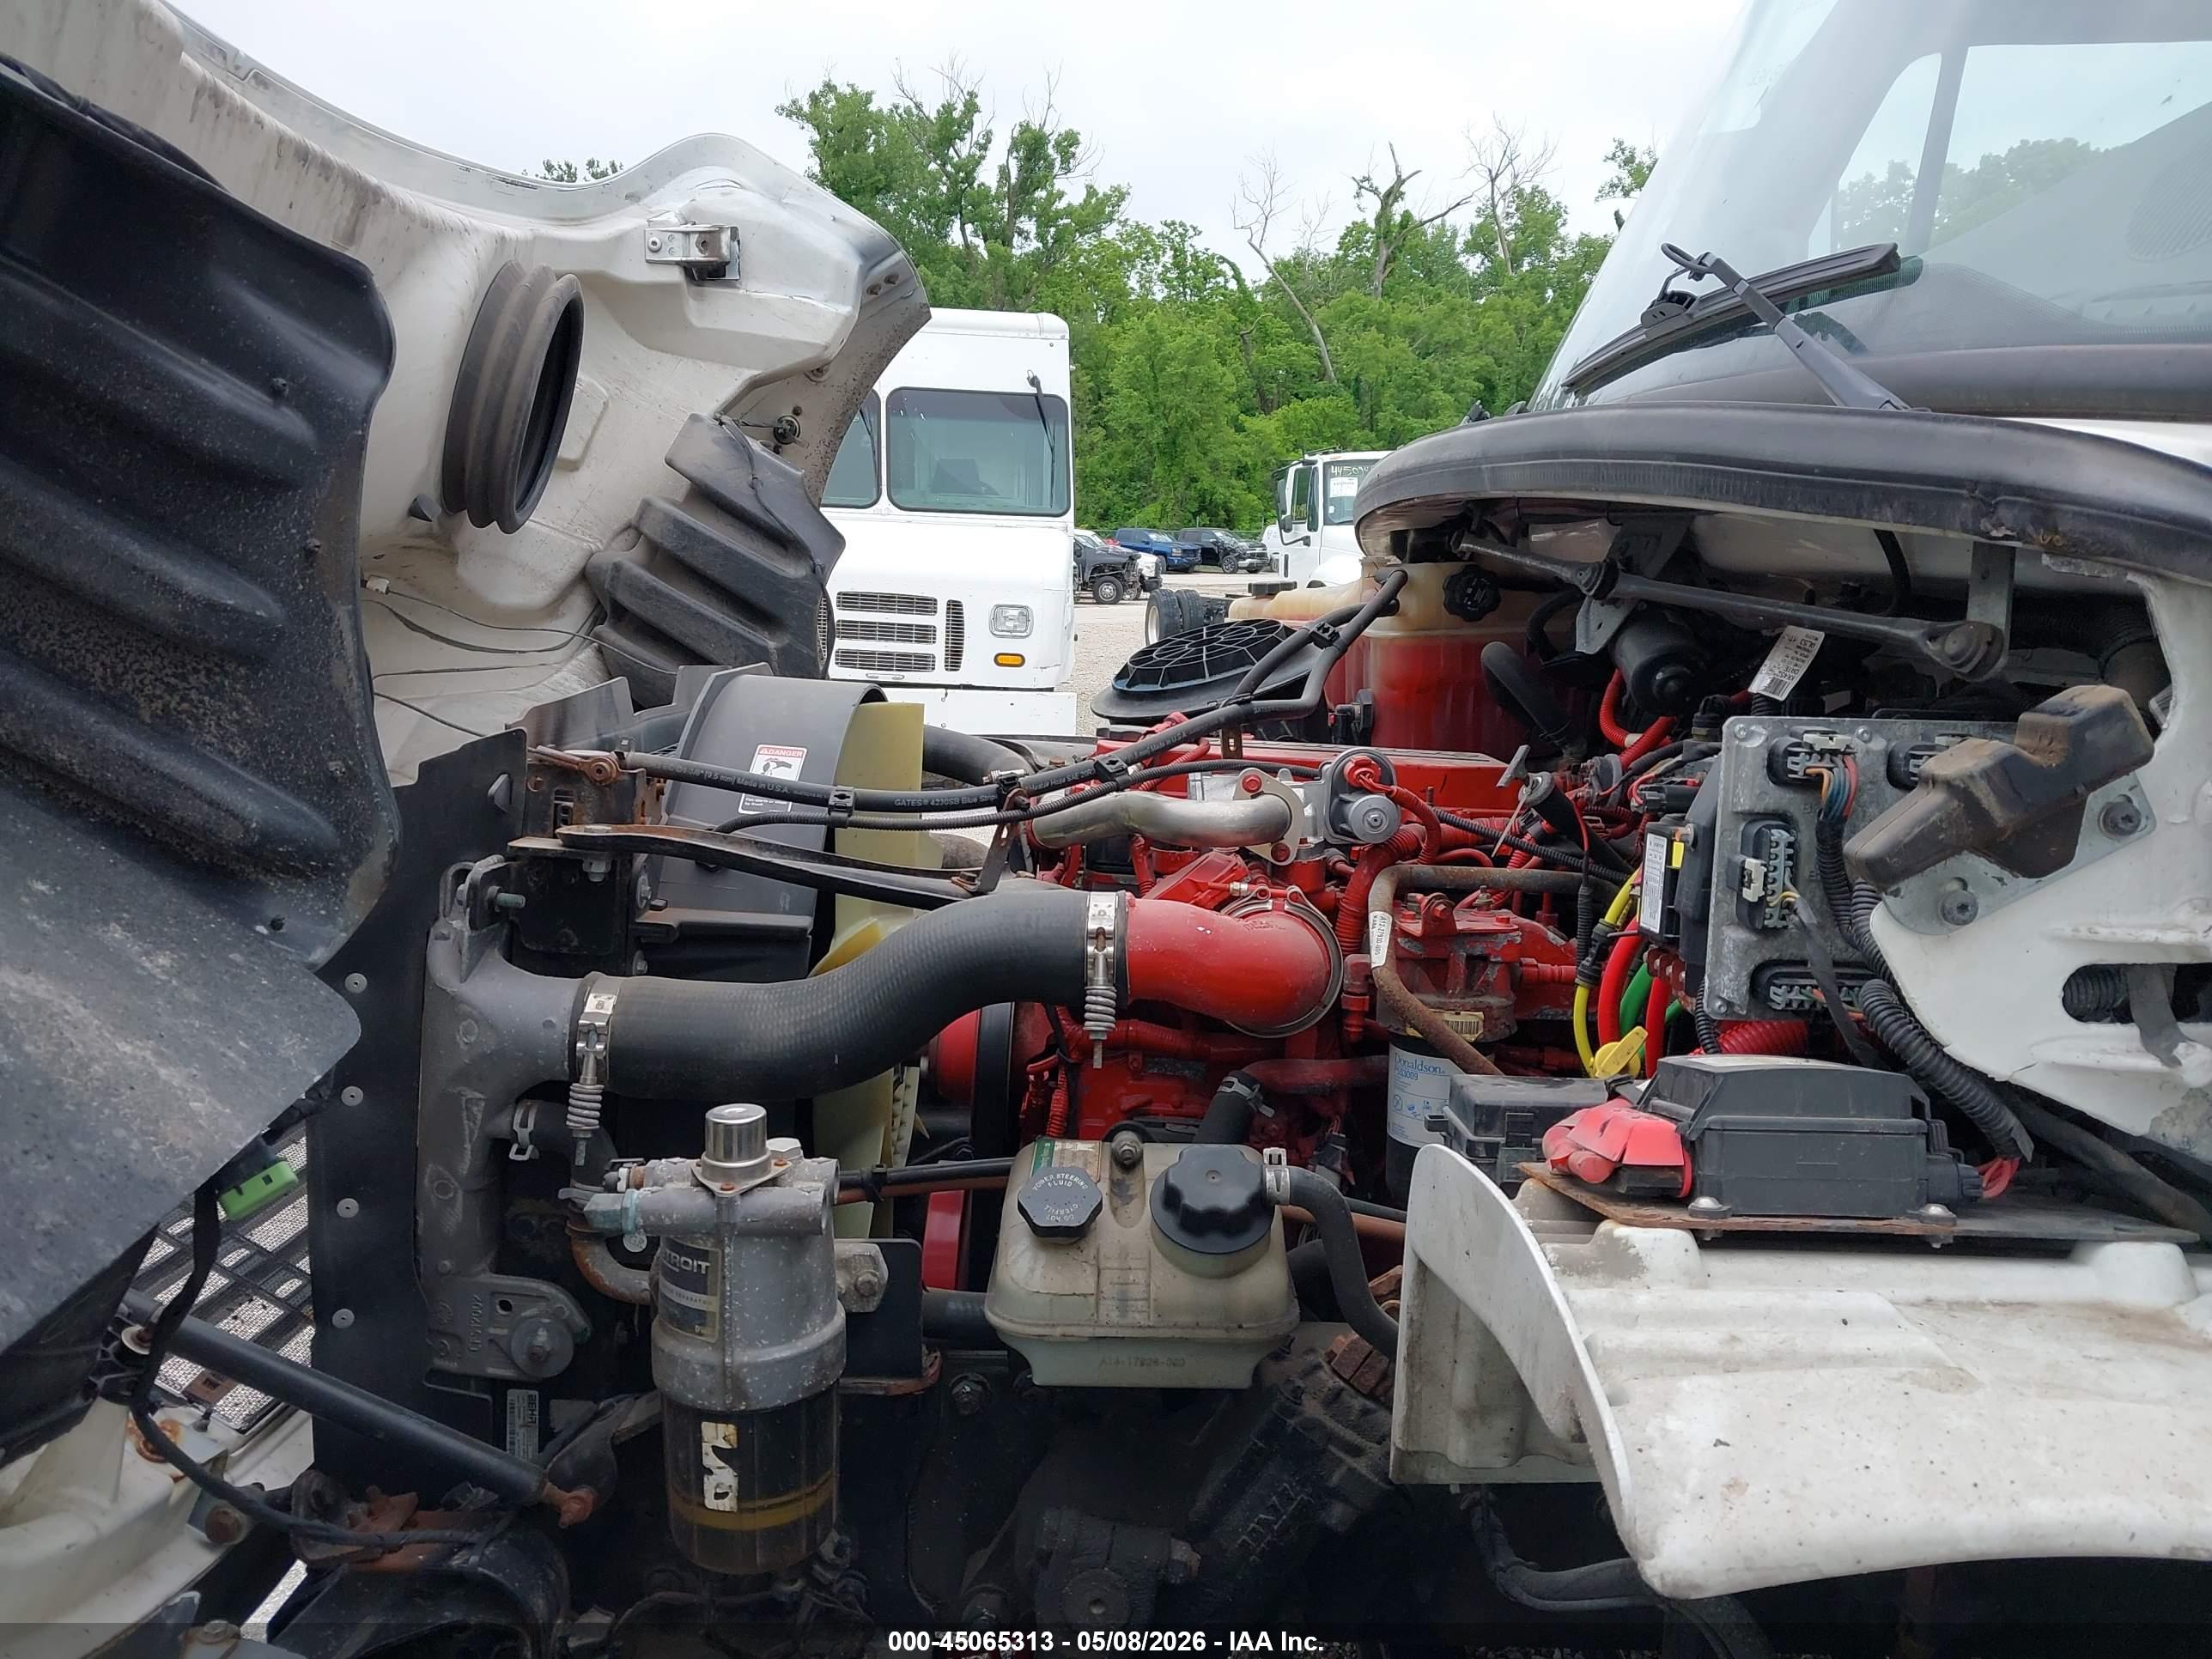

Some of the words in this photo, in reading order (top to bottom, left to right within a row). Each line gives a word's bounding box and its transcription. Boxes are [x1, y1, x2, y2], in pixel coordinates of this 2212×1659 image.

[769, 749, 803, 757] DANGER
[736, 776, 757, 787] Made
[894, 798, 922, 807] GATES
[961, 796, 978, 805] Blue
[1395, 1053, 1442, 1073] Donaldson
[1032, 1174, 1055, 1191] POWER
[1056, 1173, 1089, 1189] STEERING
[660, 1248, 710, 1274] TROIT
